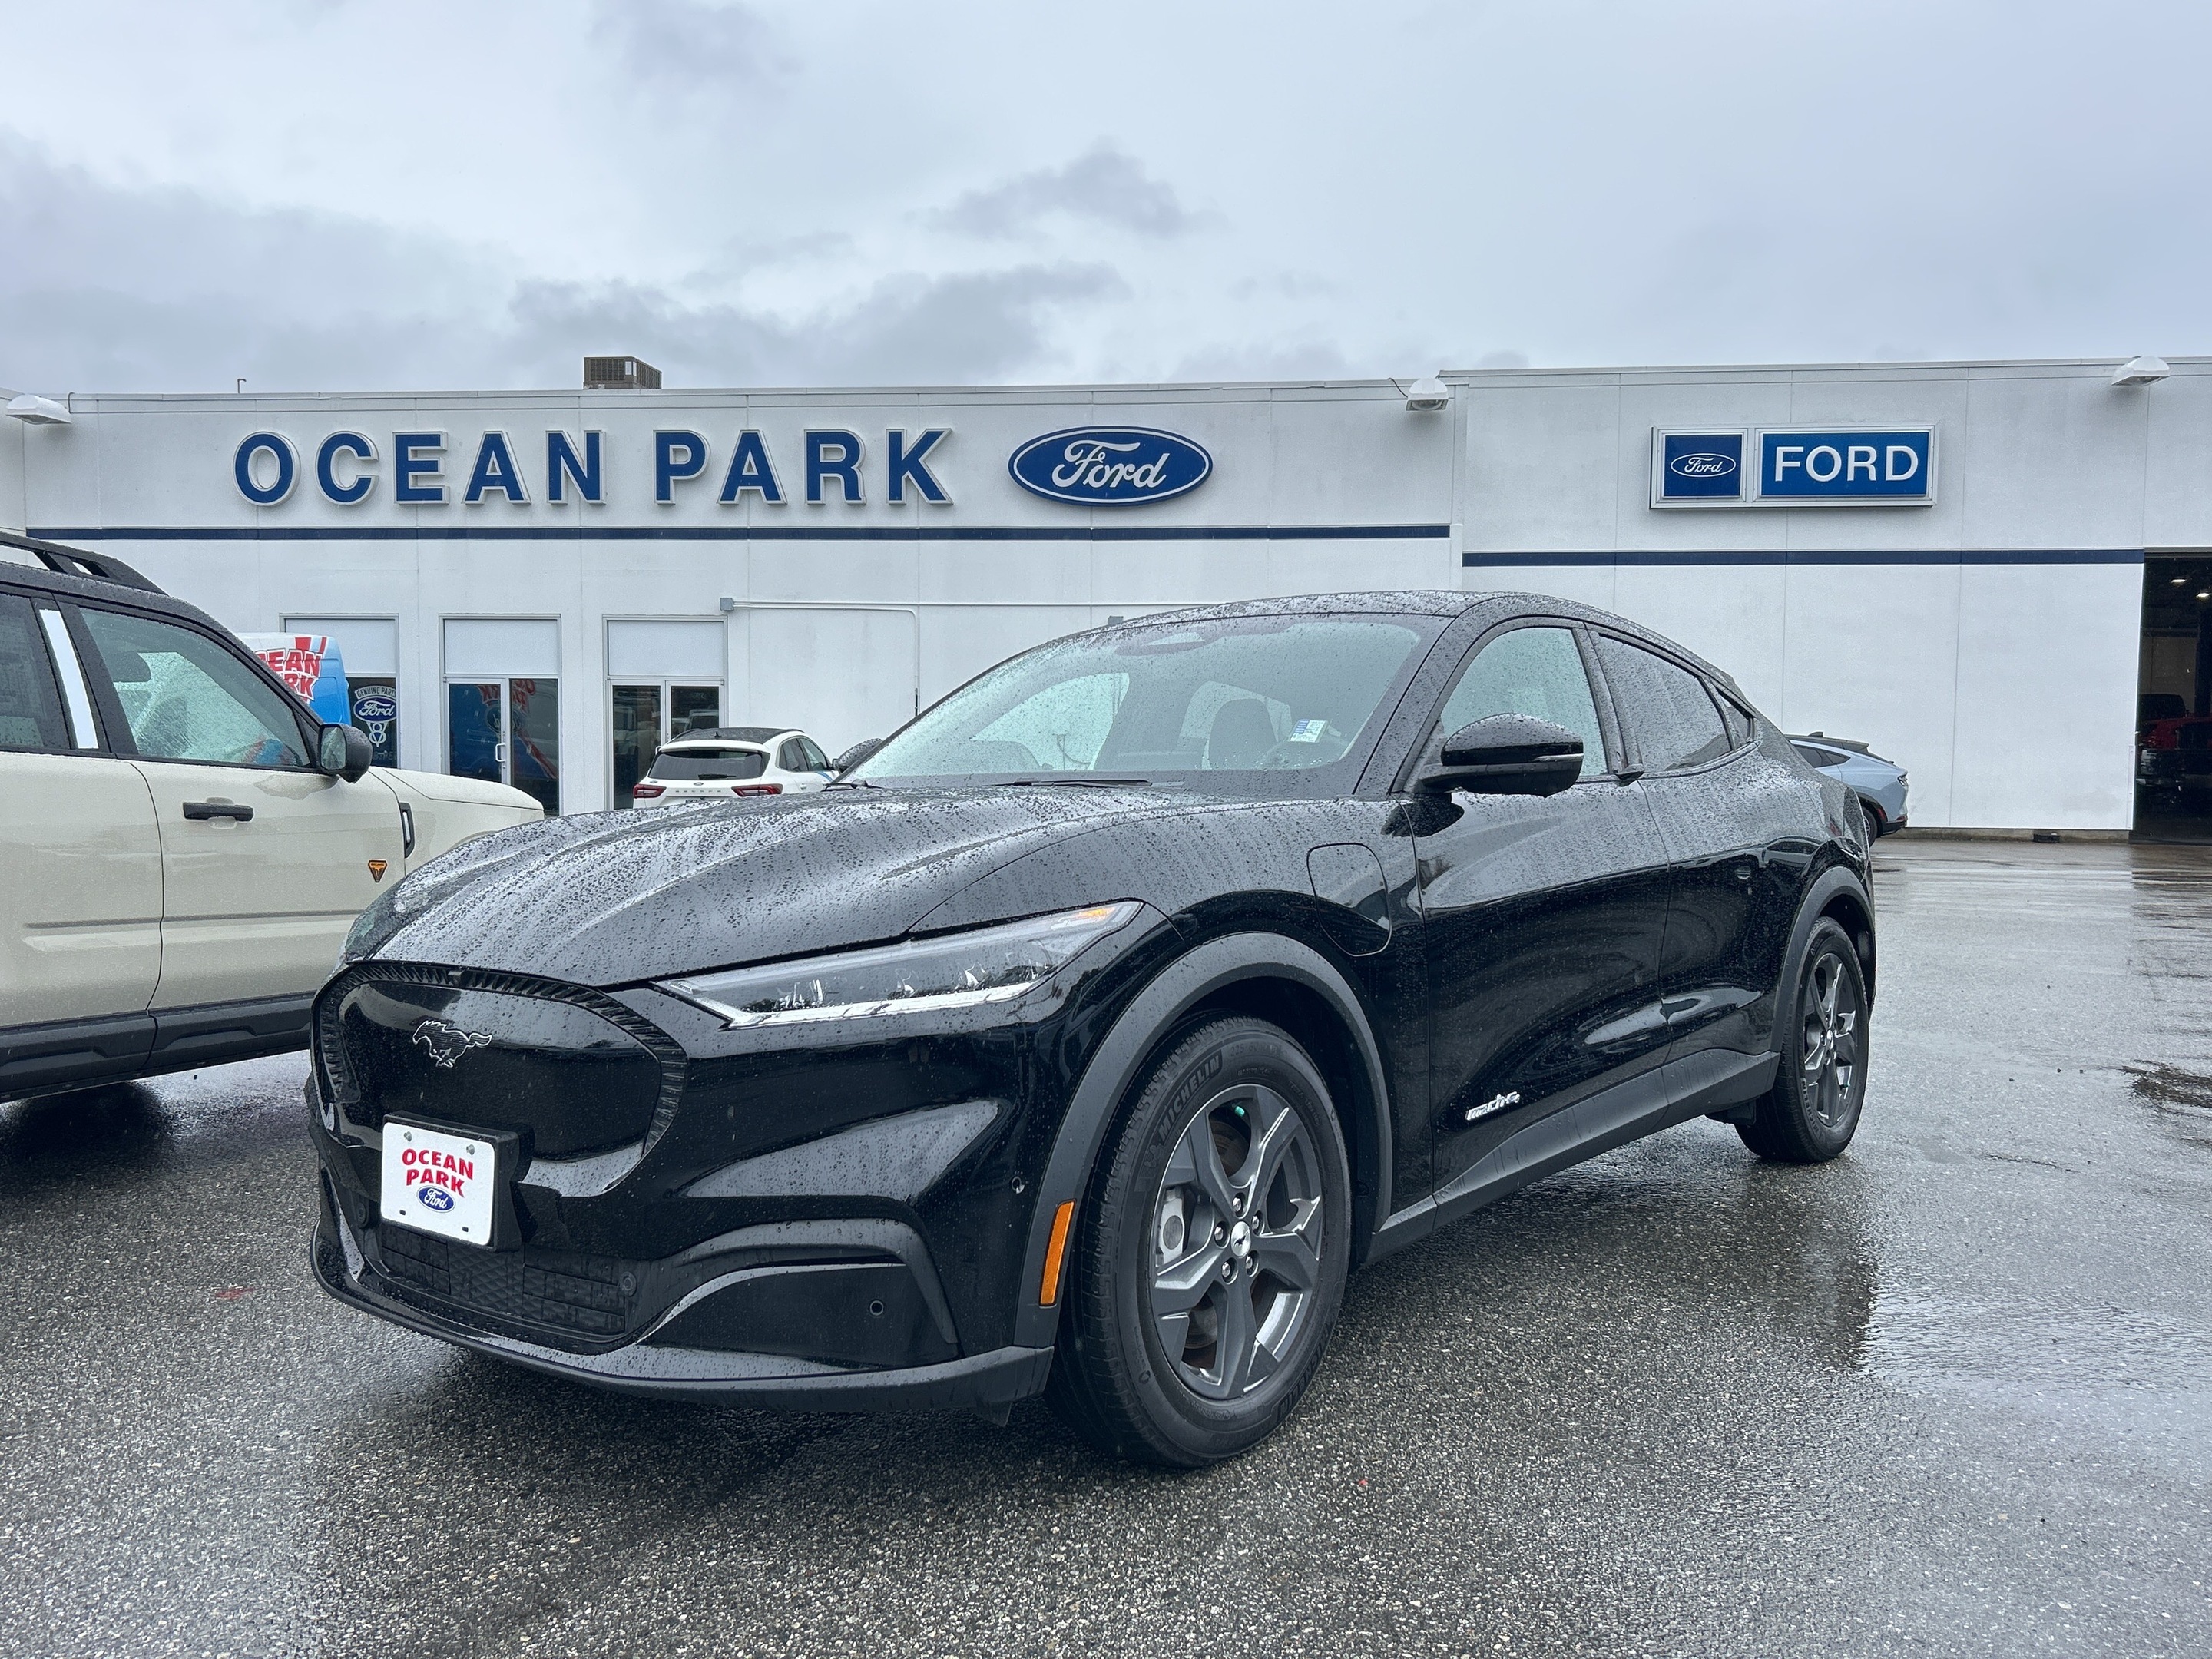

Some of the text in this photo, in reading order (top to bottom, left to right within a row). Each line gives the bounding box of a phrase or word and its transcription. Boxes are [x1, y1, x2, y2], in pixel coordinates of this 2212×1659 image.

[233, 428, 955, 507] OCEAN PARK
[1051, 439, 1167, 492] Ford
[1684, 456, 1723, 475] Ford
[1774, 445, 1919, 482] FORD
[256, 650, 322, 677] EAN
[356, 687, 380, 698] GENUINE
[359, 700, 396, 717] Ford
[1158, 1055, 1220, 1142] MICHELIN
[402, 1148, 474, 1181] OCEAN
[406, 1168, 465, 1198] PARK
[424, 1188, 449, 1210] Ford
